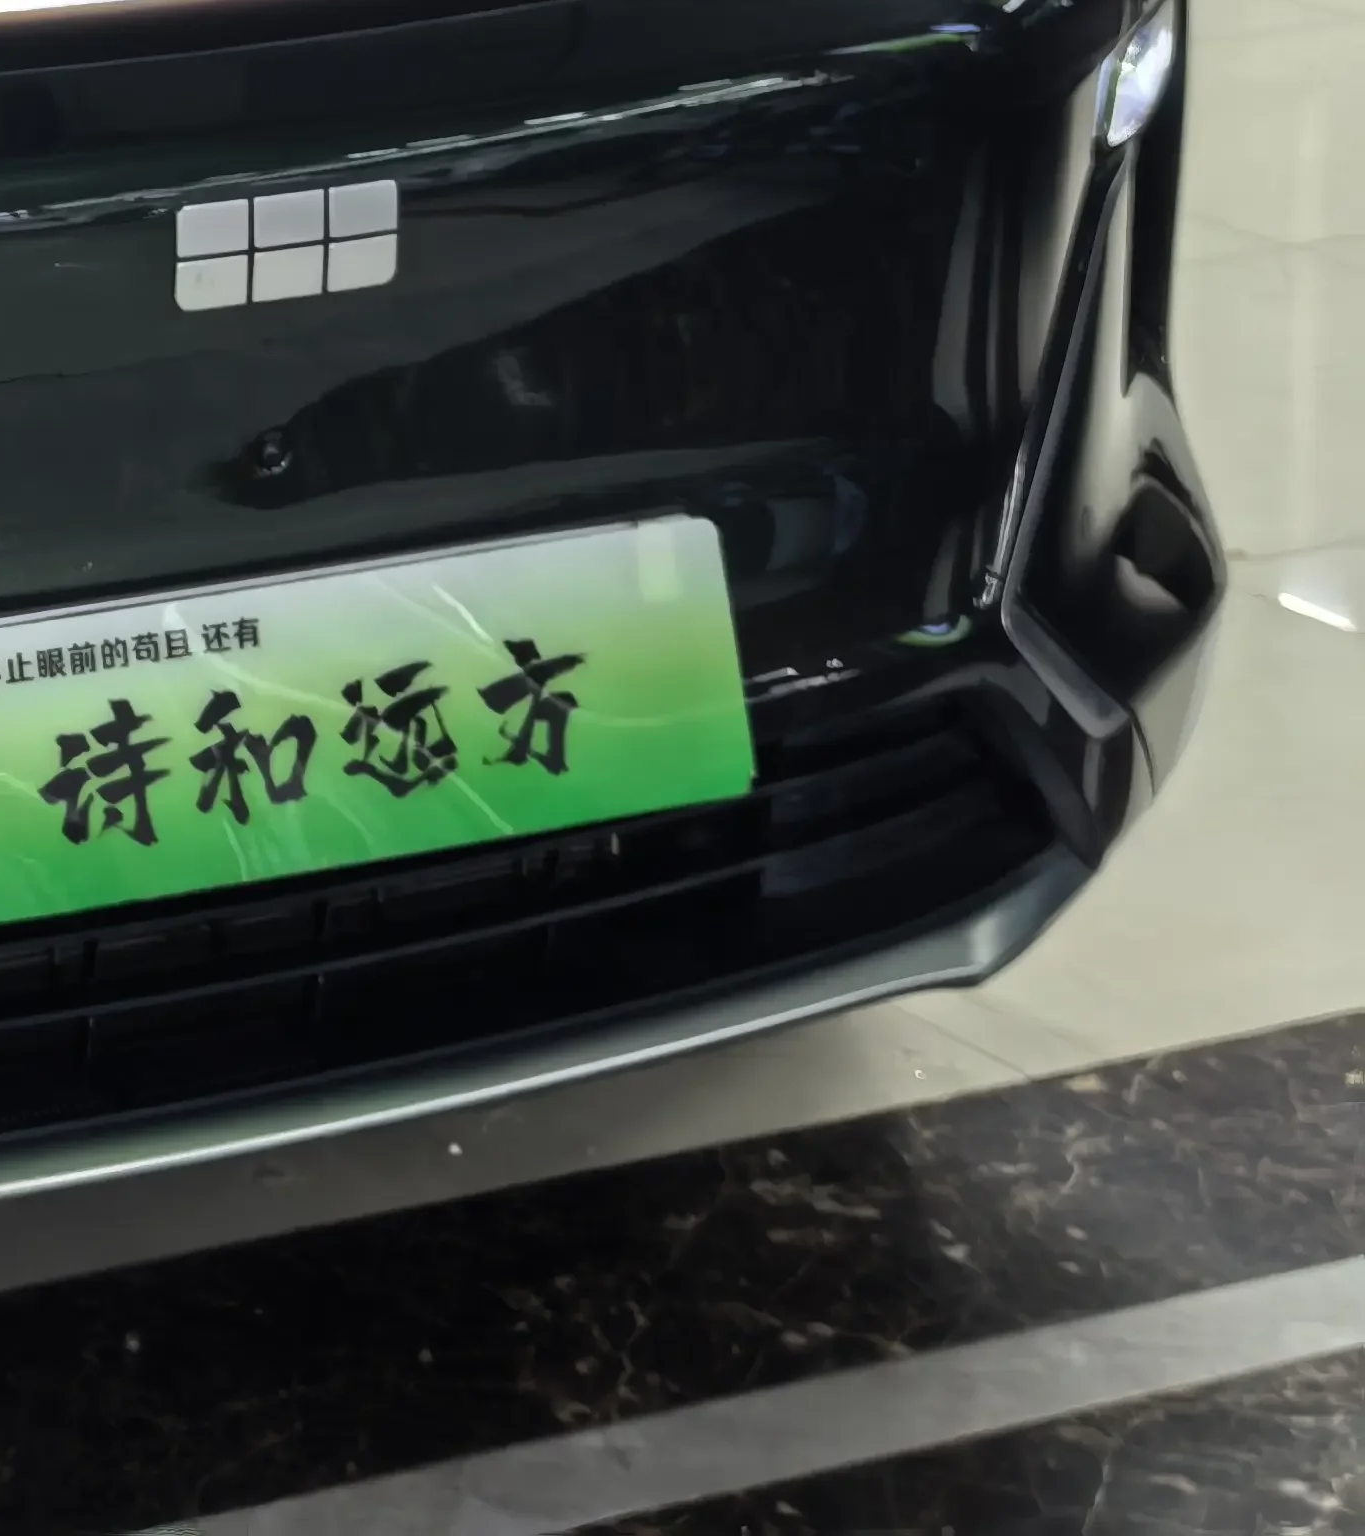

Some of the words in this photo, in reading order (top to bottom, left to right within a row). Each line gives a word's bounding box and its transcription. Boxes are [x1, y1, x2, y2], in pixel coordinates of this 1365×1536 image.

[200, 616, 260, 654] 还有
[37, 637, 588, 847] 诗和远方
